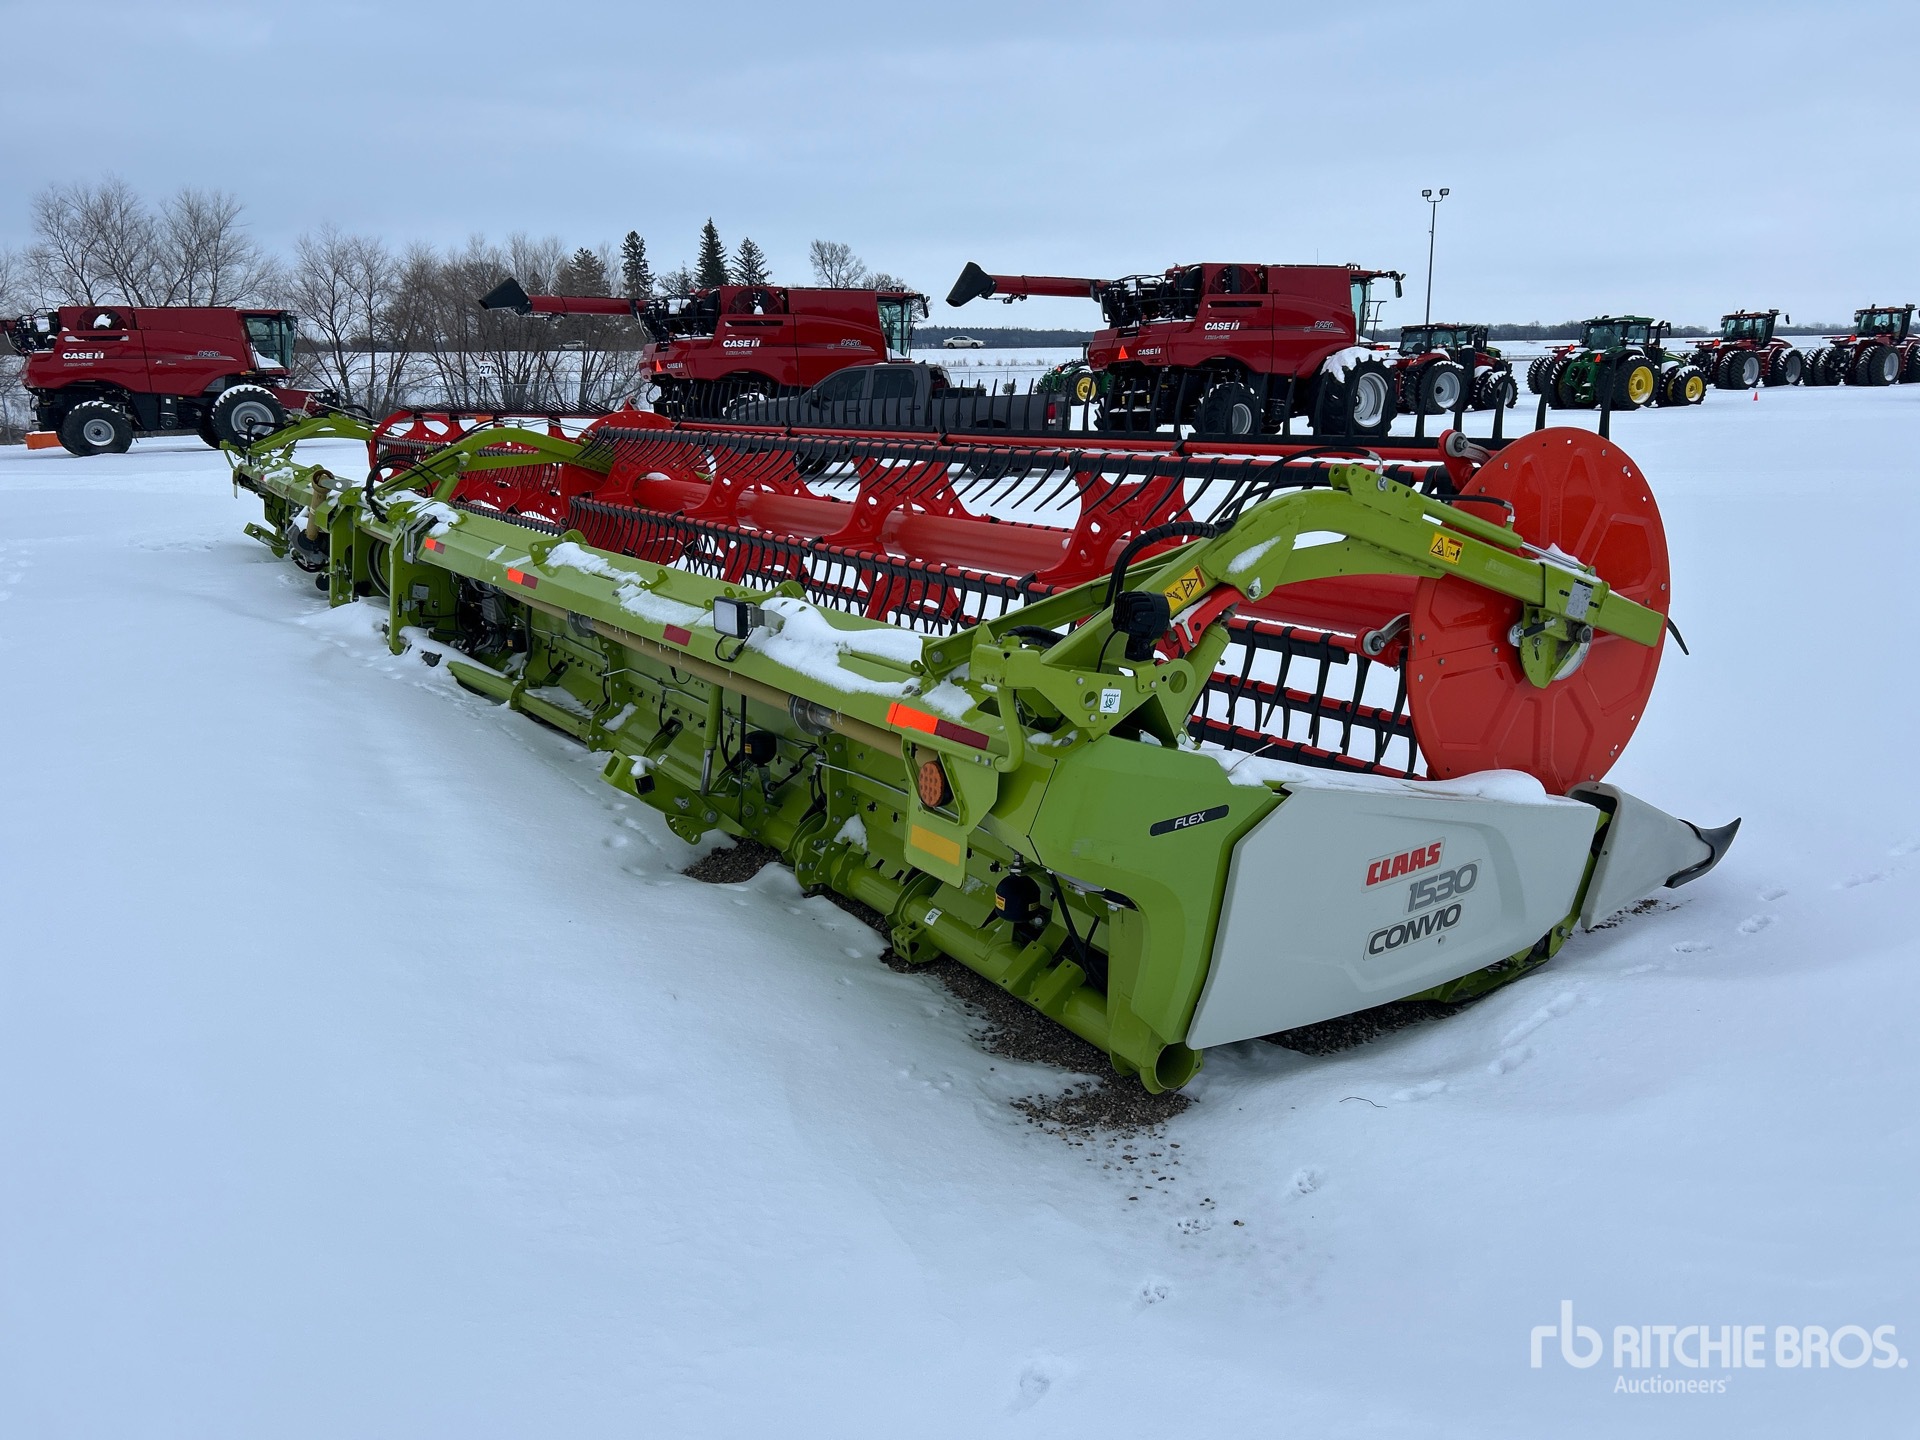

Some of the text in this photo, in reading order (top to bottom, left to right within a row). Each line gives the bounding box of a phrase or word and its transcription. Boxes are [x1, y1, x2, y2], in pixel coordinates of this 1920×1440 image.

[1204, 322, 1231, 330] CASE
[723, 340, 750, 348] CASE
[62, 352, 94, 360] CASE
[1137, 348, 1154, 356] CASE
[1174, 811, 1206, 829] FLEX
[1366, 842, 1441, 886] CLAAS
[1407, 863, 1478, 912] 1530
[1368, 904, 1462, 955] CONVIO
